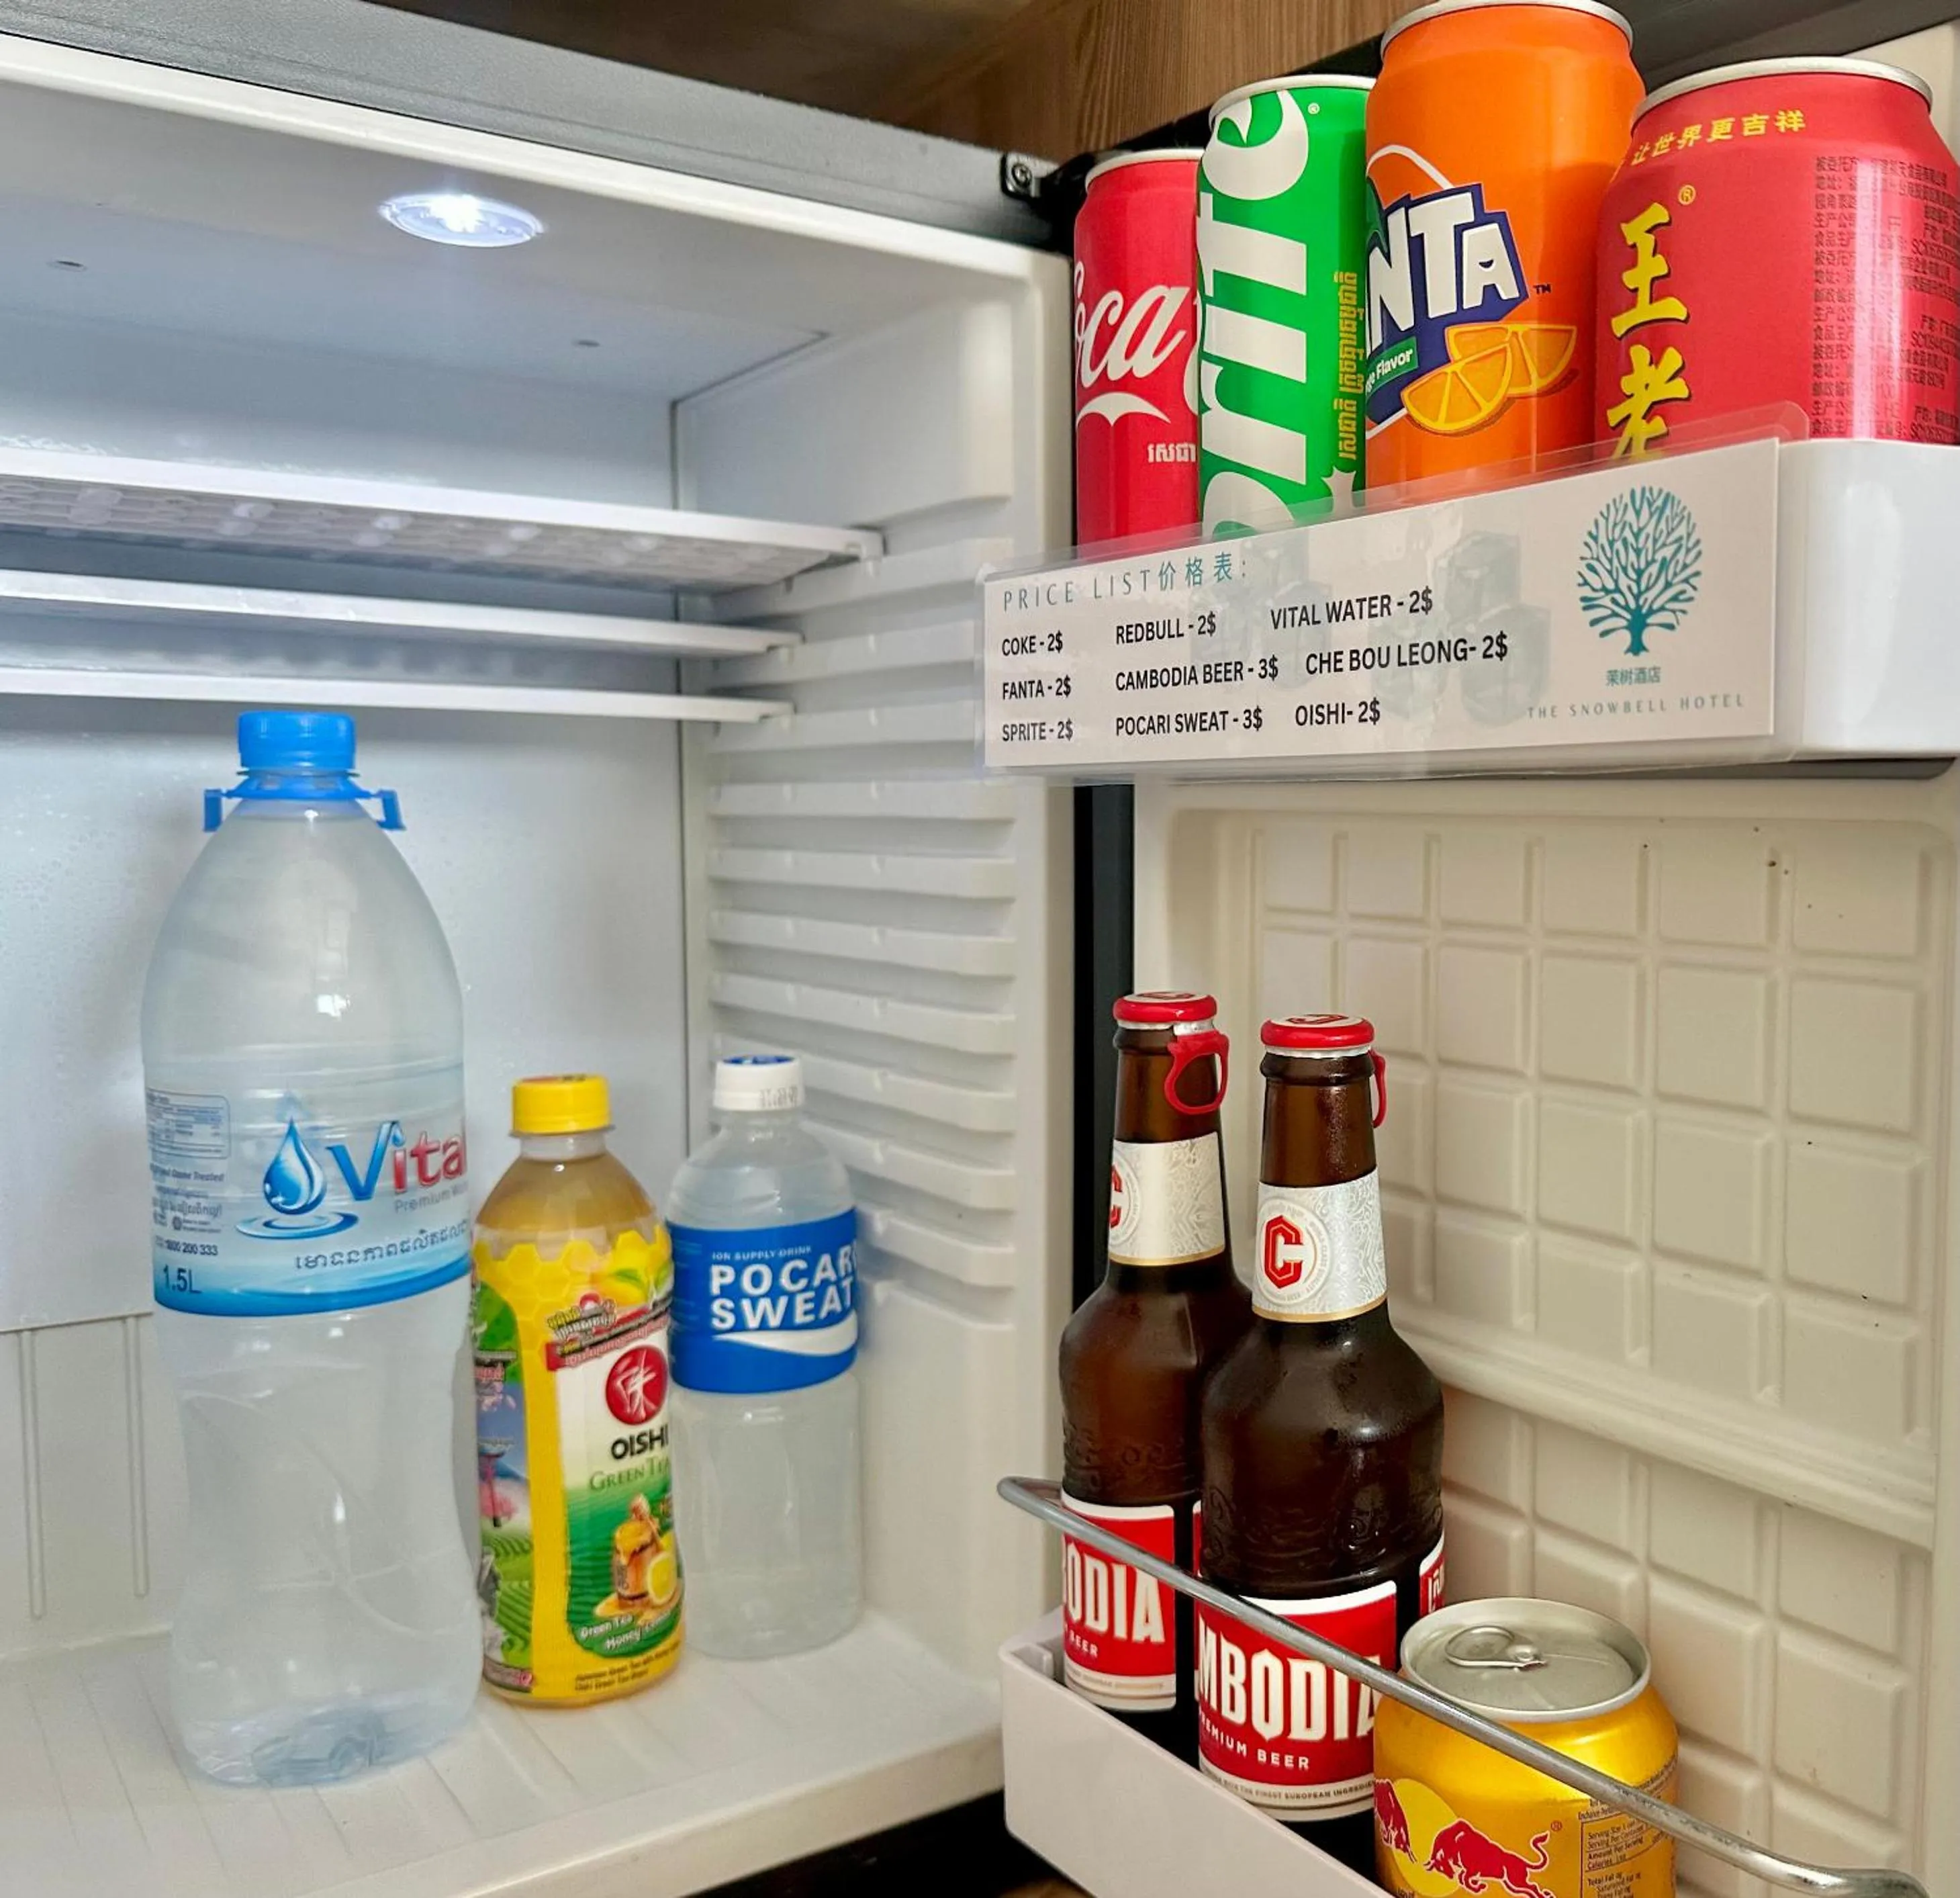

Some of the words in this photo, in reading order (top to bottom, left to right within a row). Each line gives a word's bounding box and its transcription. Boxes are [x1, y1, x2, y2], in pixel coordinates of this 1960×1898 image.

[1631, 109, 1806, 166] 让世界更吉祥
[1366, 192, 1520, 359] NTA
[1376, 349, 1413, 379] Flavor
[1147, 442, 1197, 463] រសជា
[1004, 581, 1074, 611] PRICE
[1270, 605, 1321, 630] VITAL
[1325, 594, 1391, 623] WATER
[1409, 586, 1433, 616] 2$
[1002, 635, 1037, 656] COKE
[1047, 630, 1064, 653] 2$
[1116, 617, 1184, 645] REDBULL
[1197, 611, 1216, 637] 2$
[1305, 650, 1344, 676] CHE
[1349, 645, 1391, 671] BOU
[1482, 630, 1508, 662] 2$
[1002, 680, 1045, 700] FANTA
[1056, 674, 1071, 698] 2$
[1115, 665, 1199, 691] CAMBODIA
[1203, 661, 1244, 684] BEER
[1258, 654, 1279, 682] 3$
[1115, 714, 1170, 737] POCARI
[1174, 711, 1229, 733] SWEAT
[1242, 705, 1263, 732] 3$
[1358, 697, 1381, 726] 2$
[1528, 706, 1558, 719] THE
[1569, 698, 1667, 717] SNOWBELL
[1680, 694, 1744, 711] HOTEL
[1002, 722, 1046, 742] SPRITE
[1058, 718, 1074, 741] 2$
[394, 1189, 451, 1214] Premium
[182, 1241, 198, 1255] 200
[199, 1244, 219, 1256] 333
[712, 1251, 731, 1261] ION
[735, 1249, 775, 1261] SUPPLY
[779, 1245, 812, 1259] DRINK
[1264, 1214, 1304, 1290] C
[163, 1265, 201, 1295] 1.5L
[711, 1275, 853, 1330] SWEAT
[1061, 1534, 1166, 1643] ODIA
[1257, 1748, 1310, 1770] BEER
[1285, 1791, 1331, 1800] EUROPEAN
